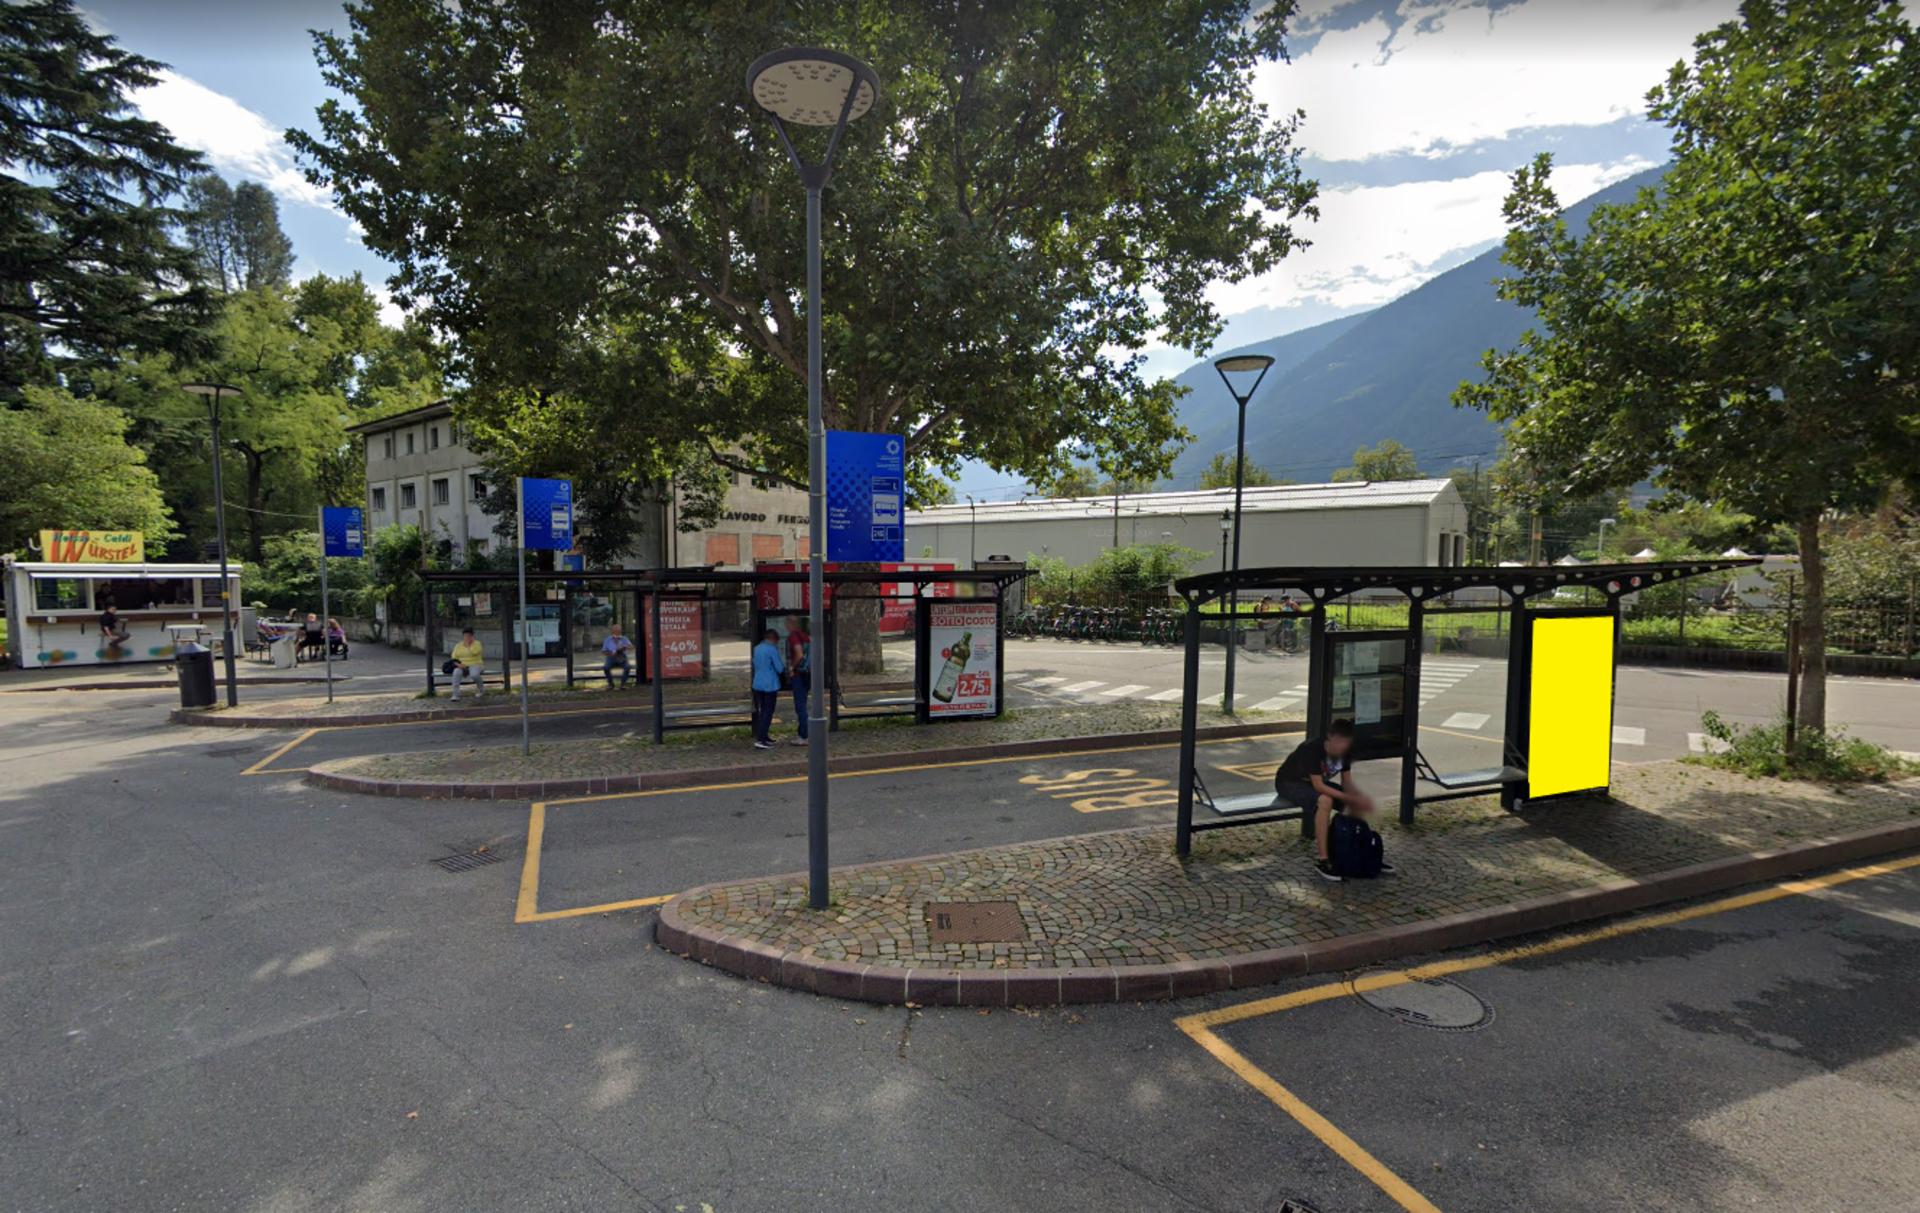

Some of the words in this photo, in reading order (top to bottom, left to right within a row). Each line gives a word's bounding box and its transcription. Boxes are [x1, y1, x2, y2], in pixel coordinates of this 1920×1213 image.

[720, 512, 766, 522] LAVORO
[932, 616, 964, 626] SOTTO
[965, 617, 996, 625] COSTO
[664, 640, 698, 652] -40%
[960, 679, 986, 695] 2,75
[1018, 768, 1179, 814] BUS
